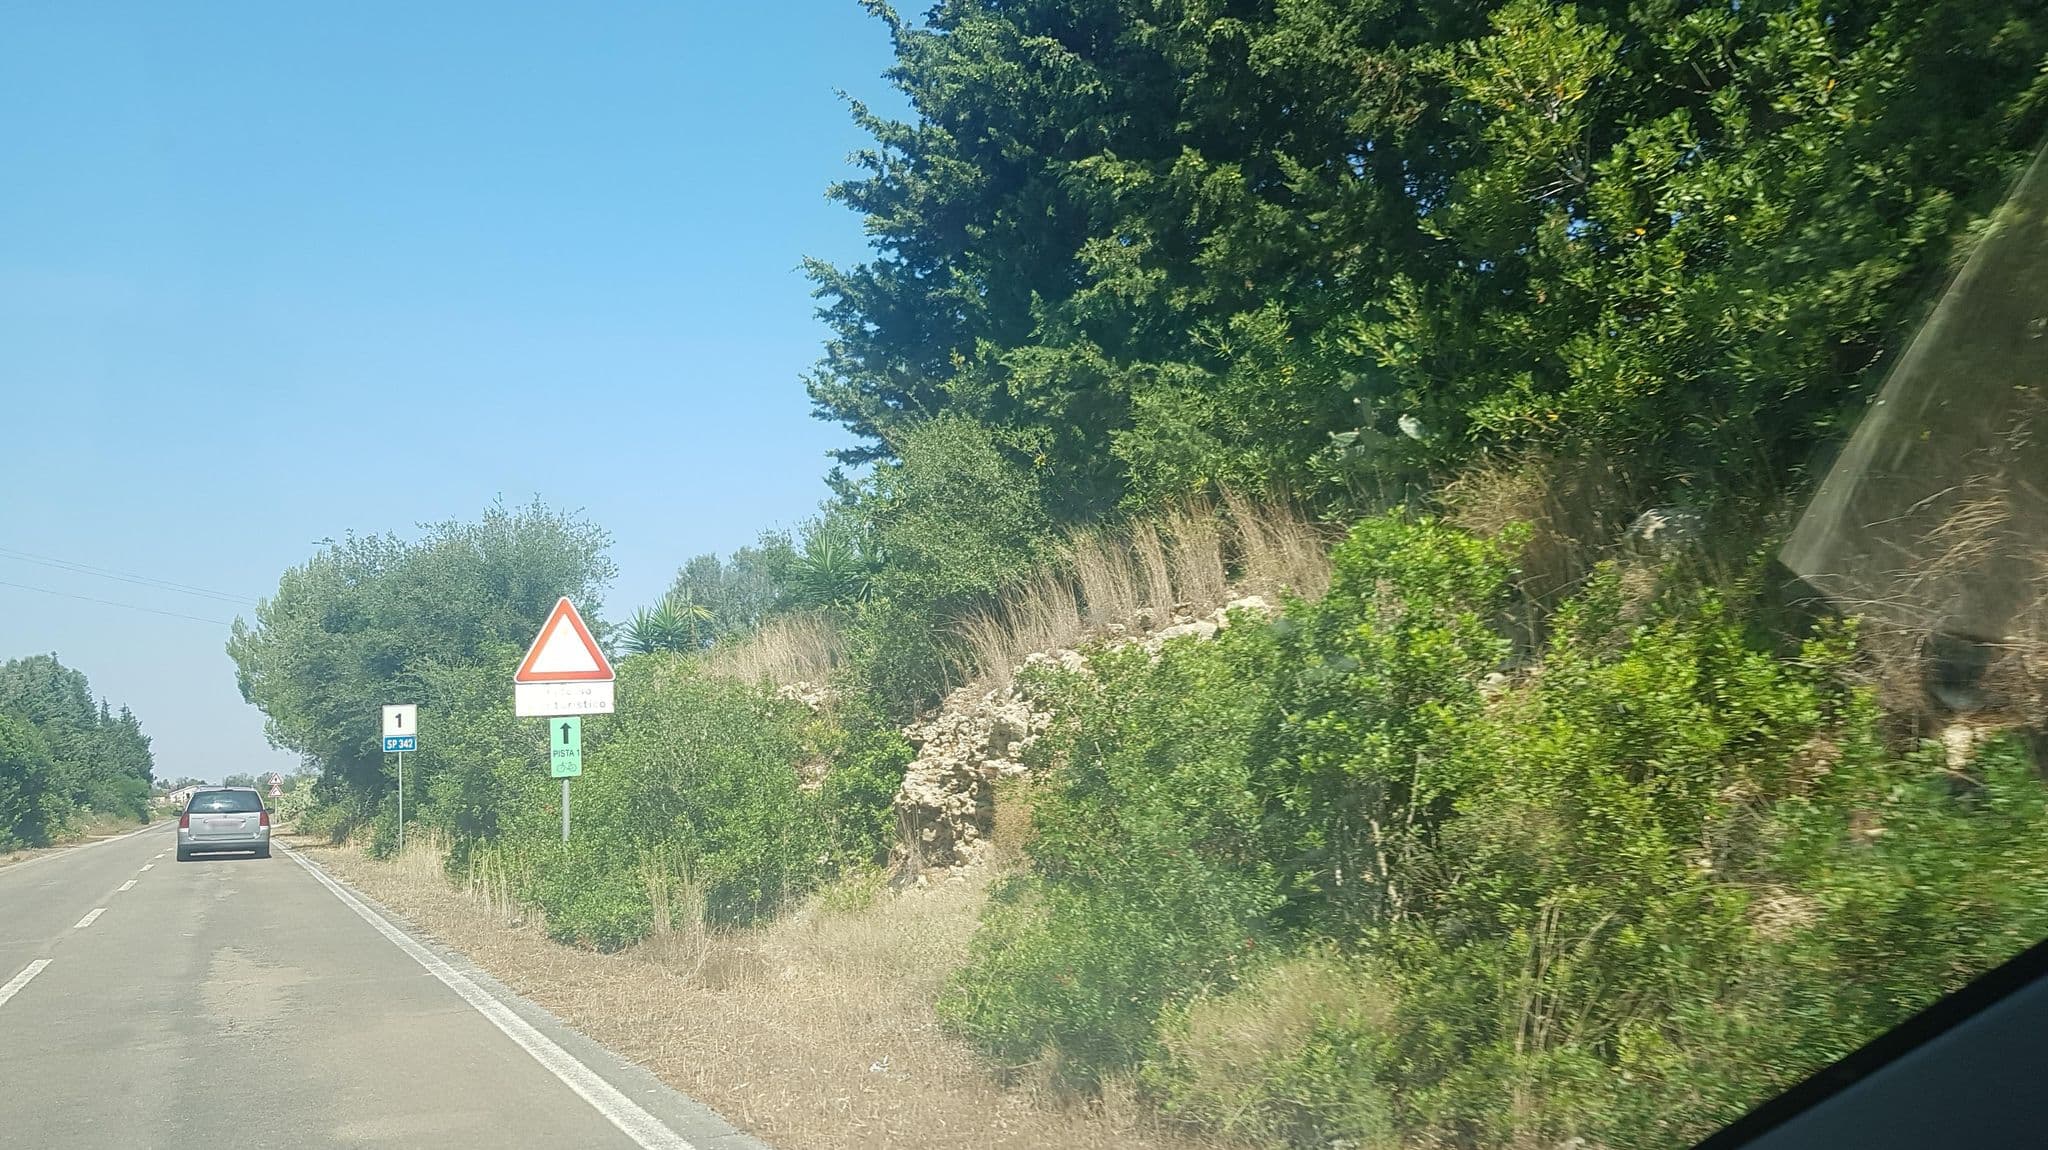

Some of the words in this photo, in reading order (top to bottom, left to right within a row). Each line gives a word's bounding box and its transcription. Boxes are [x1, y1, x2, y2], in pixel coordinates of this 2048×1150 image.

[395, 713, 402, 728] 1
[386, 739, 398, 750] SP
[398, 738, 413, 749] 342
[553, 749, 575, 758] PISTA
[576, 749, 580, 757] 1
